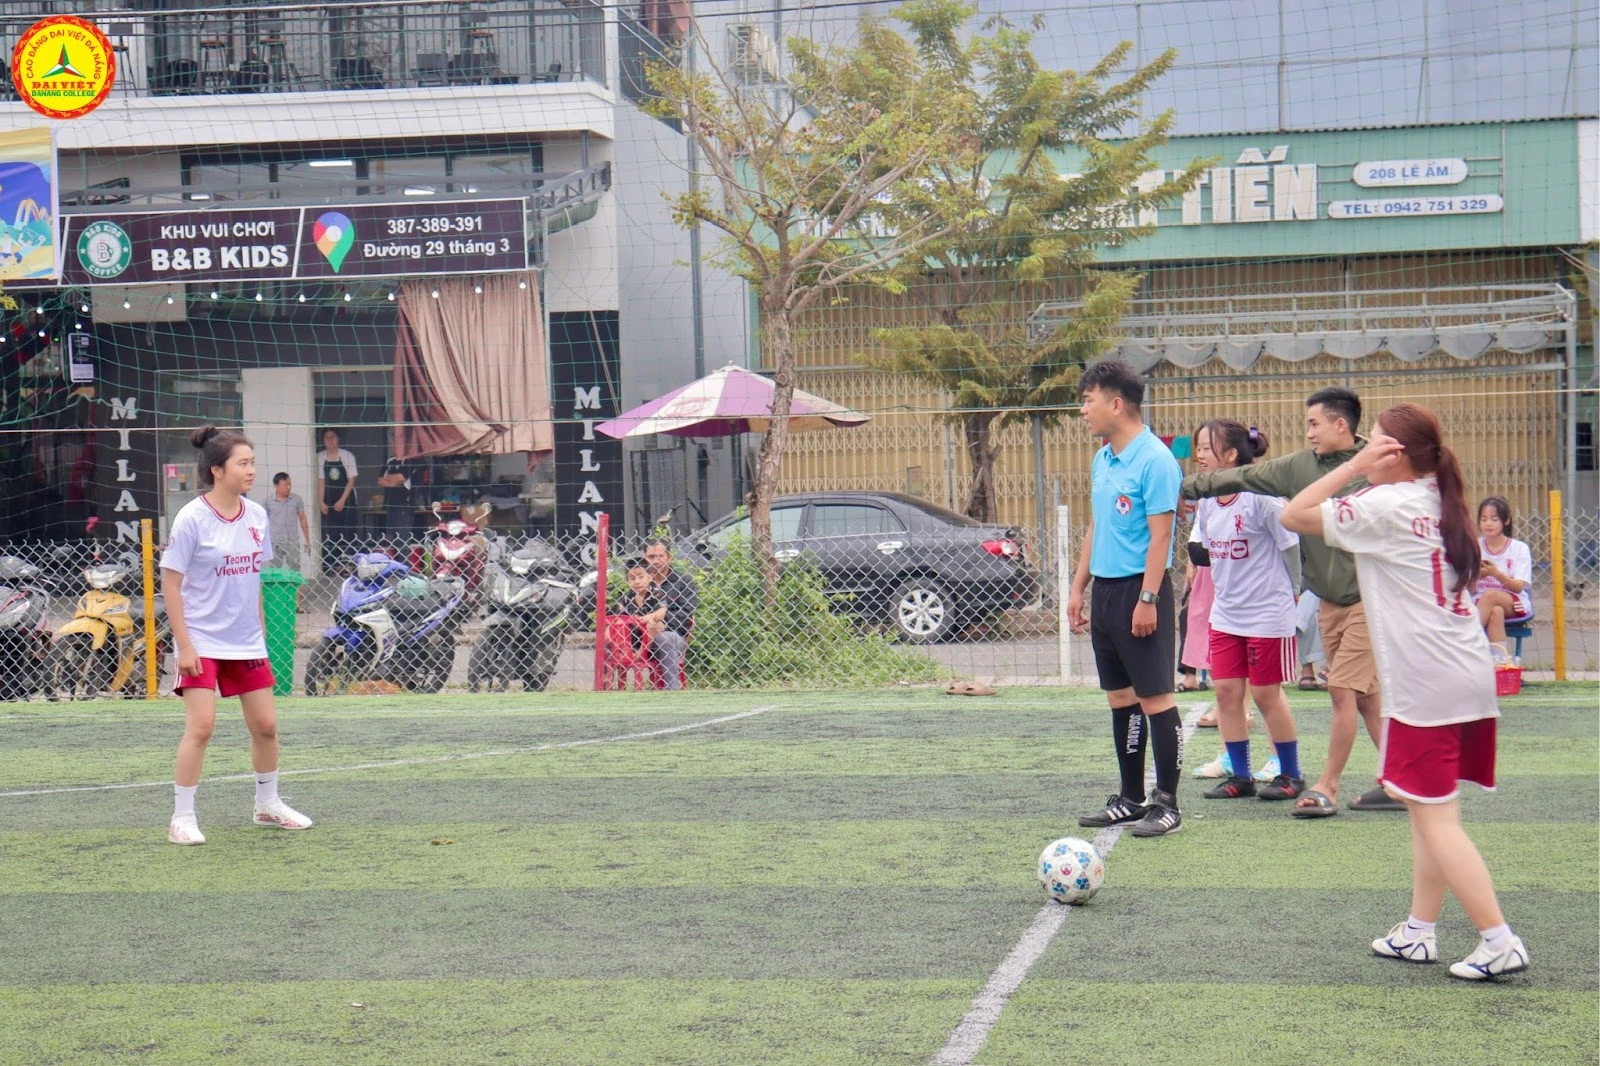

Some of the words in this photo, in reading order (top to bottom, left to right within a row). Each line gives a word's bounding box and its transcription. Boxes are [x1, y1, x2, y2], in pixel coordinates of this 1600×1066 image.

[1369, 168, 1396, 179] 208
[1173, 144, 1318, 225] TIẾN
[1344, 204, 1379, 215] TEL:
[1384, 202, 1421, 214] 0942
[1428, 201, 1453, 212] 751
[1460, 199, 1488, 210] 329
[160, 224, 197, 240] KHU
[200, 223, 229, 239] VUI
[232, 221, 275, 237] CHƠI
[387, 215, 483, 235] 387-389-391
[363, 242, 422, 260] Đường
[425, 240, 445, 256] 29
[449, 239, 496, 257] tháng
[500, 238, 510, 253] 3
[150, 247, 212, 272] B&B
[220, 244, 289, 270] KIDS
[88, 263, 123, 277] COFFEE
[223, 555, 251, 566] Team
[214, 565, 251, 577] Viewer
